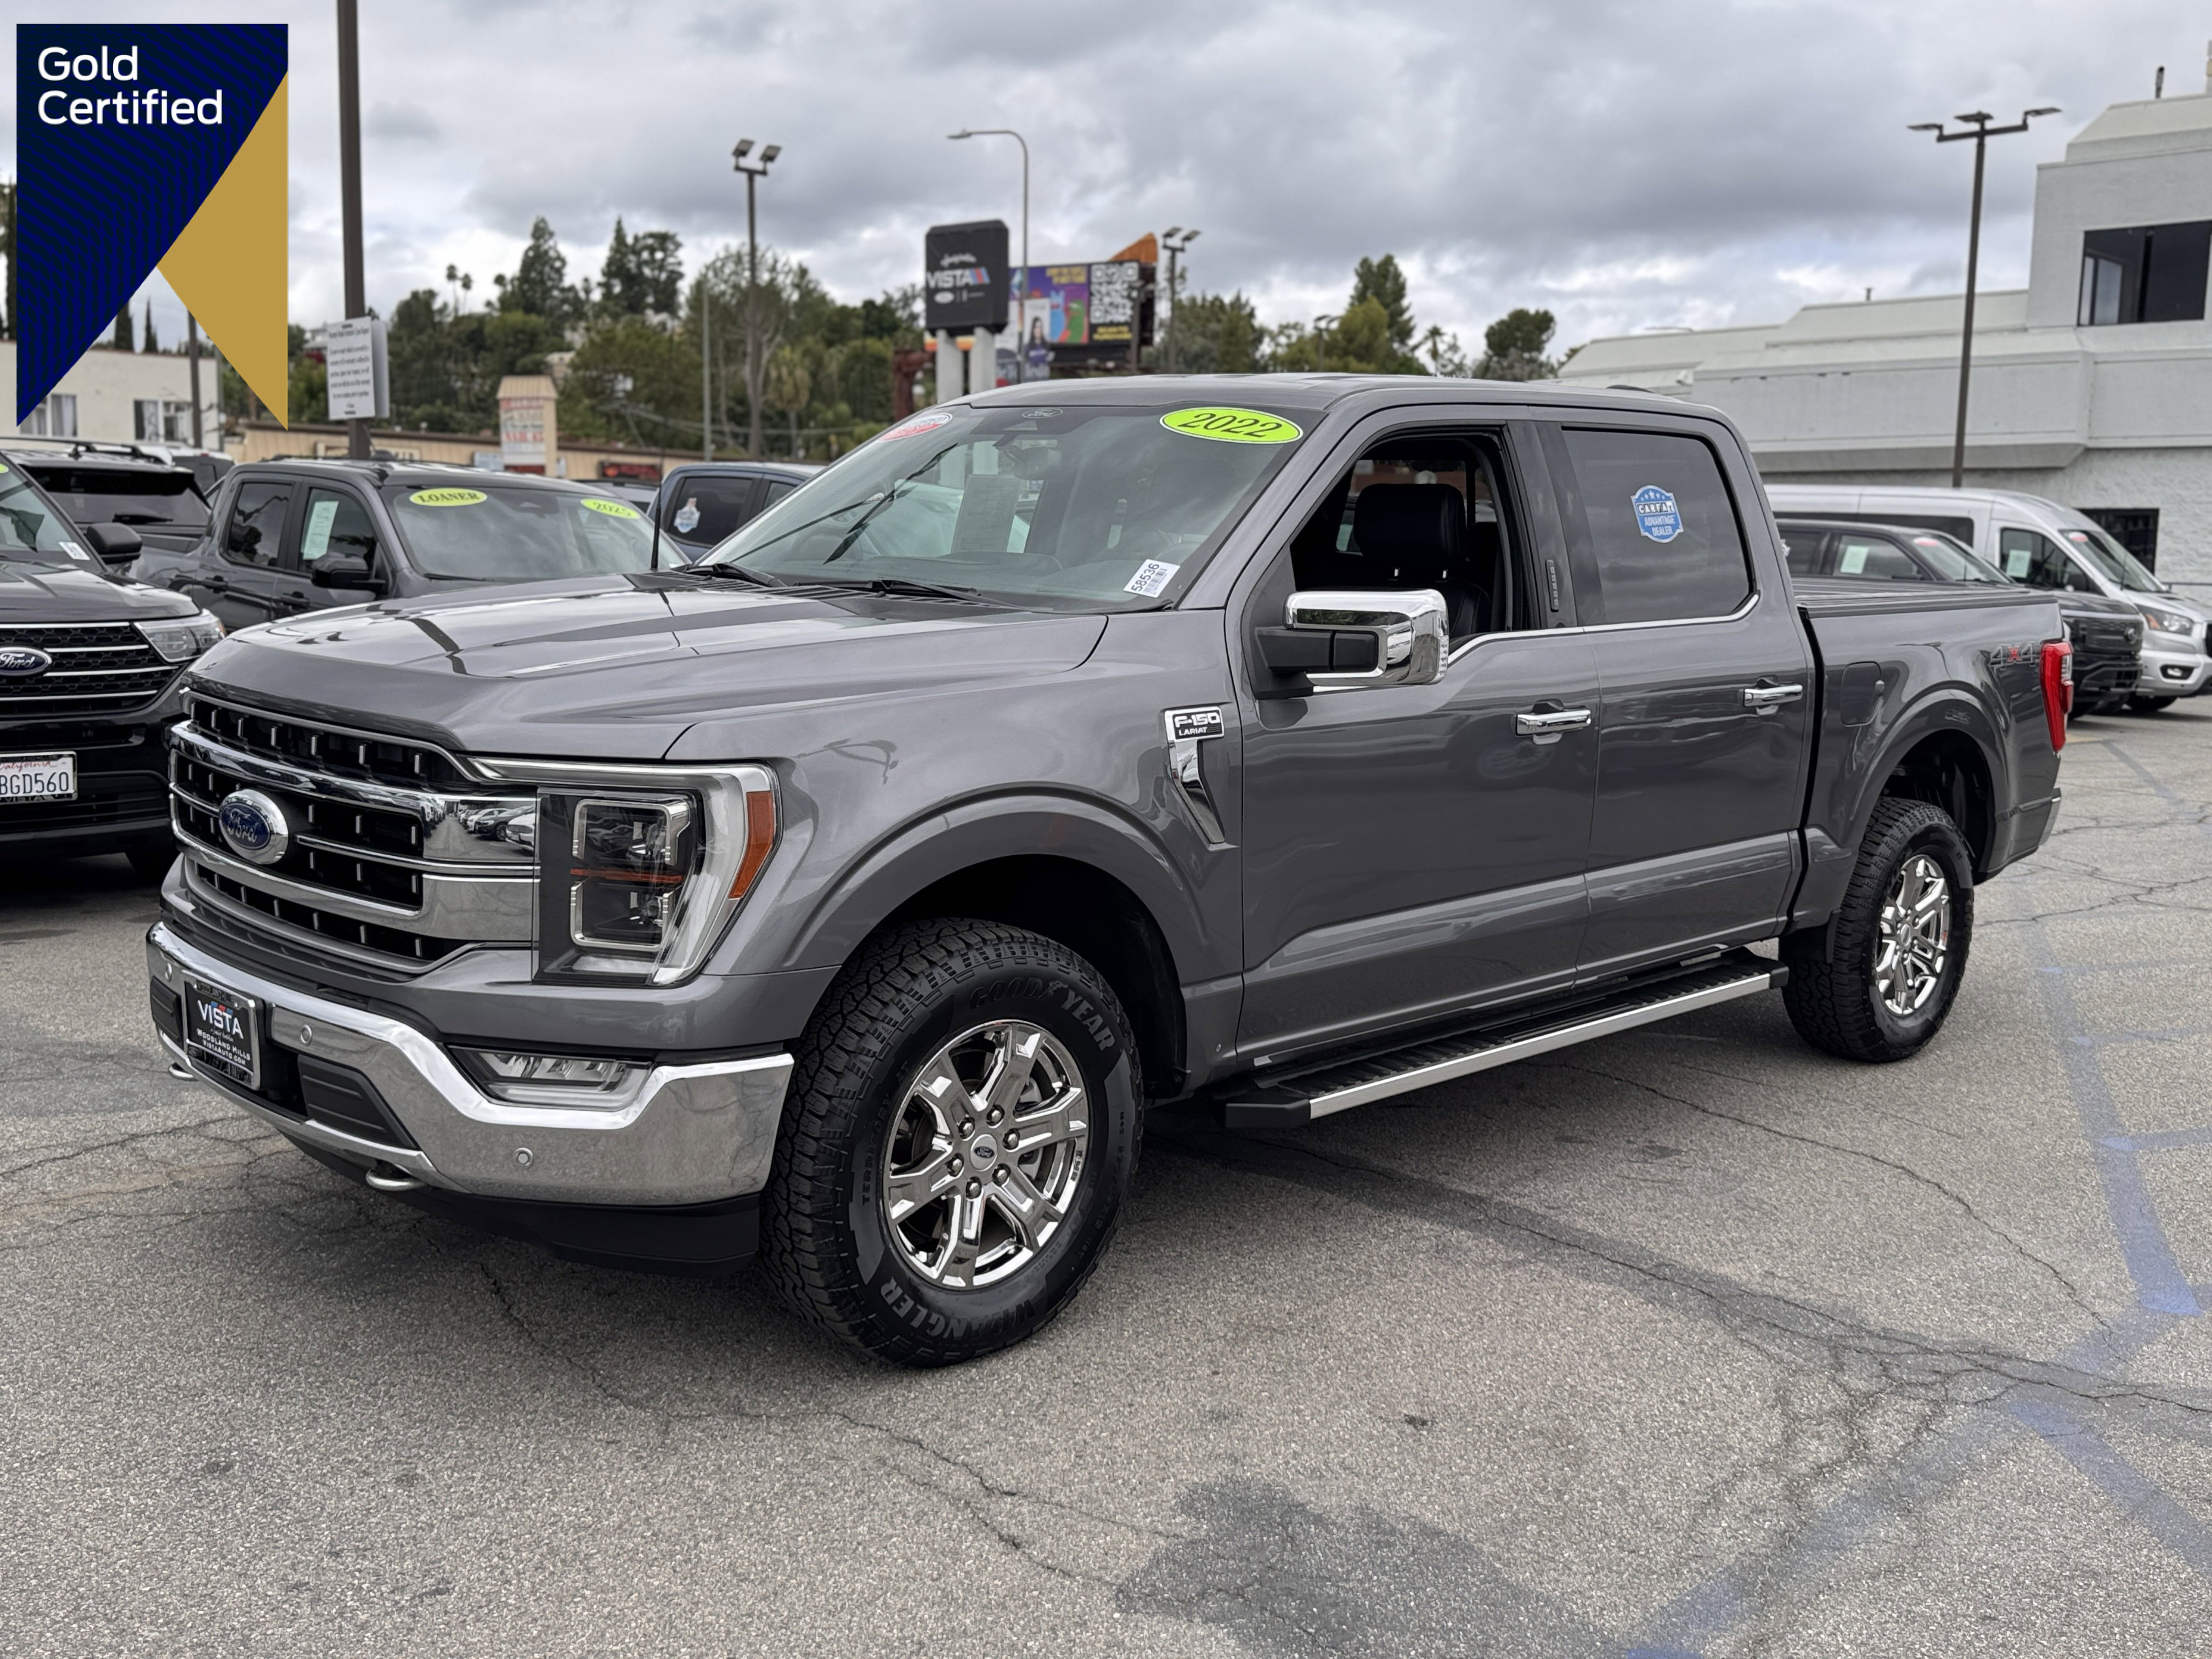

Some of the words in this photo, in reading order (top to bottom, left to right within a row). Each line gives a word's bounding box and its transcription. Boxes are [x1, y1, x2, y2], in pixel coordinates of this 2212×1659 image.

[927, 268, 974, 289] VISTA
[1177, 413, 1283, 438] 2022
[417, 493, 481, 503] LOANER
[1638, 502, 1674, 514] CARFAX
[1645, 515, 1675, 527] ADVANTAGE
[1652, 526, 1673, 537] DEALER
[1131, 563, 1159, 592] 58536
[0, 652, 35, 669] Ford
[1175, 712, 1220, 728] F-150
[1179, 726, 1207, 736] LARIAT
[228, 808, 259, 843] Ford
[198, 1000, 244, 1040] VISTA
[197, 1028, 231, 1051] WOODLAND
[233, 1045, 251, 1062] HILLS
